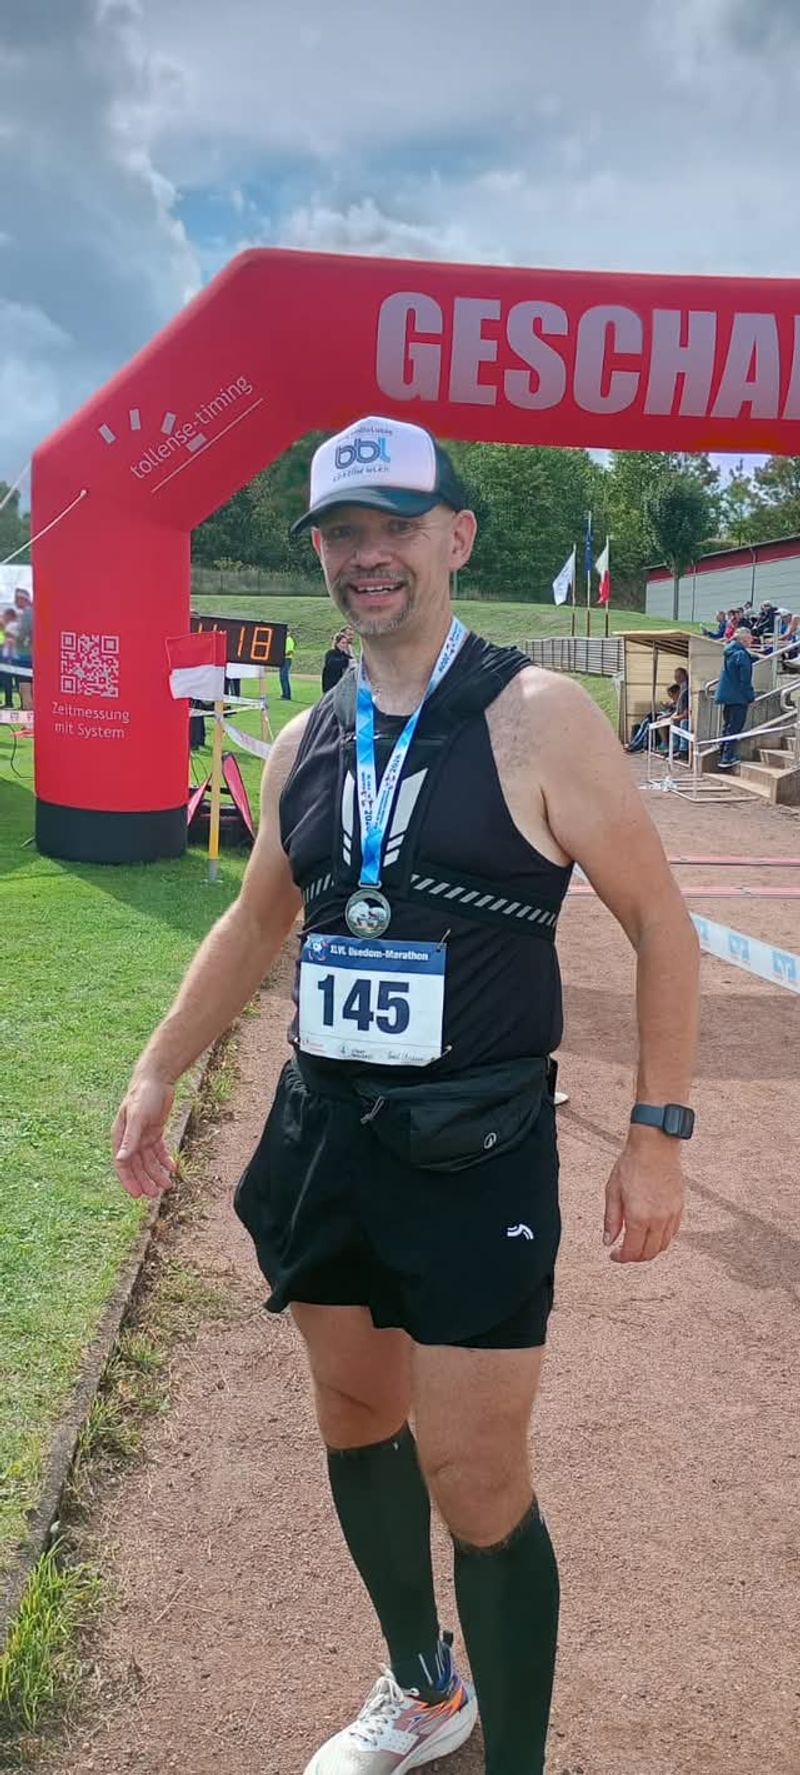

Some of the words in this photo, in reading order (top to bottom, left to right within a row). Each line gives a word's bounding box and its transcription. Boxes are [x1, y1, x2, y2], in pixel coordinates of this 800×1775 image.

[130, 376, 253, 479] tollense-timing
[52, 701, 130, 724] Zeitmessung
[54, 722, 74, 735] mit
[77, 723, 125, 739] System
[348, 947, 429, 961] Usedom-Marathon
[318, 974, 410, 1034] 145
